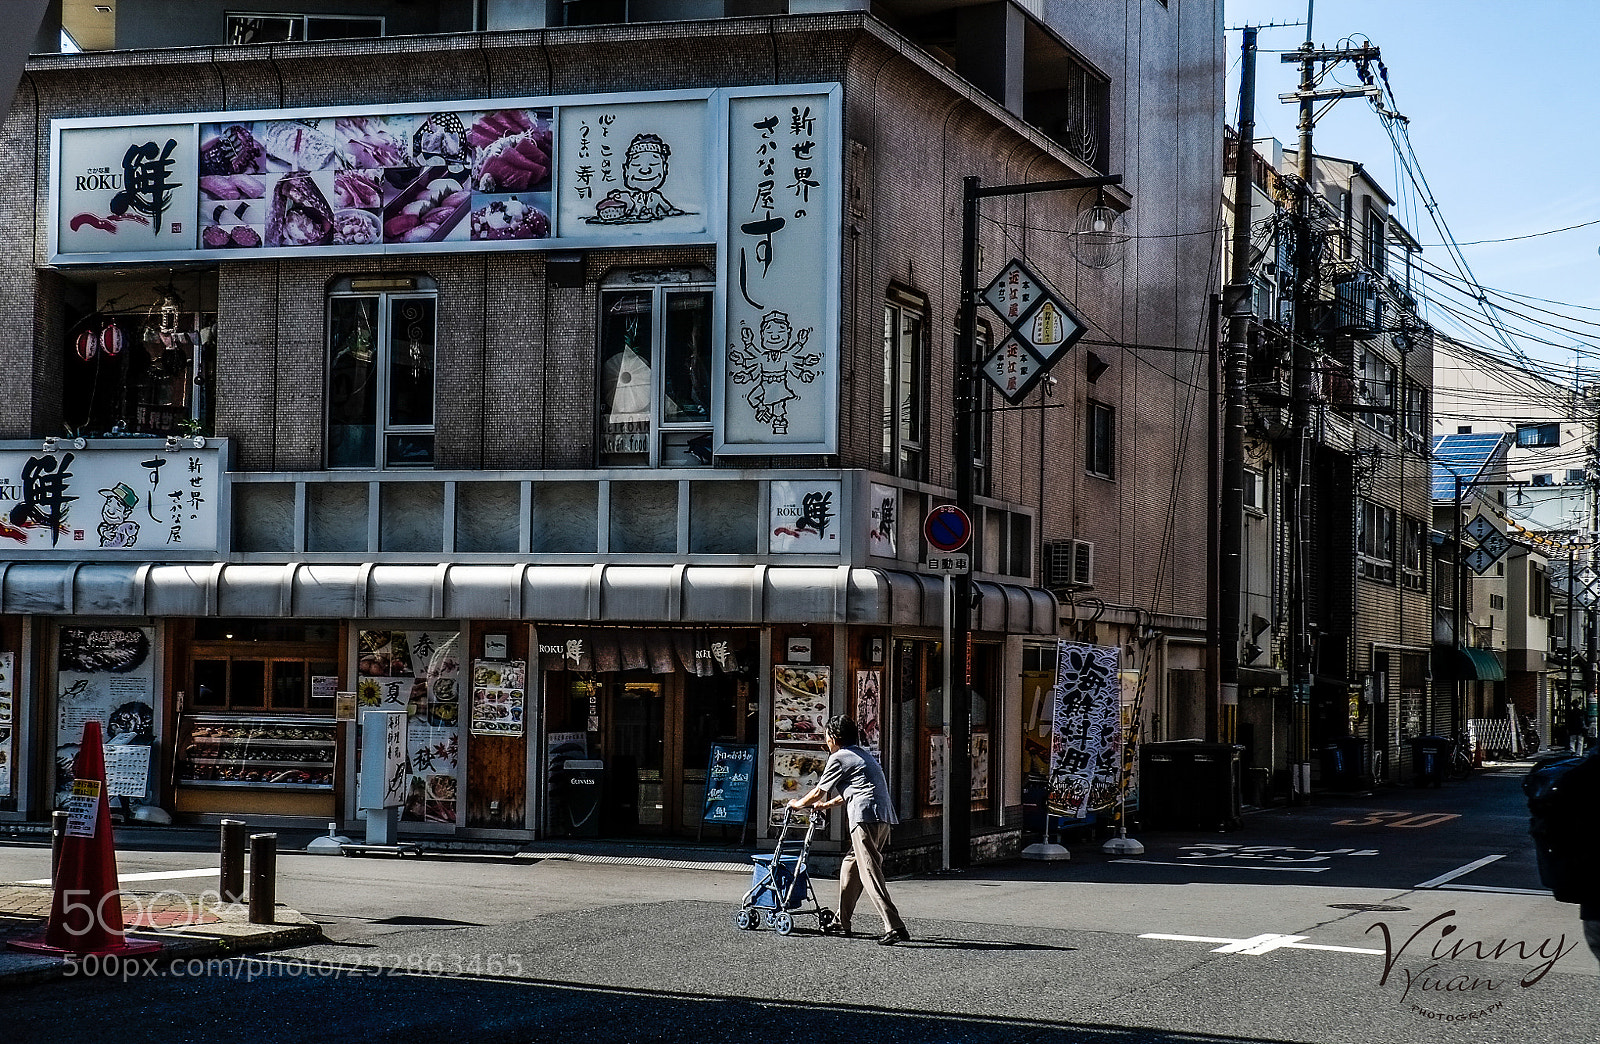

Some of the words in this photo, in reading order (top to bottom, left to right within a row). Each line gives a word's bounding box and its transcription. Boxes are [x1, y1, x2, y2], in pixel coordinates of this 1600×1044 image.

[574, 120, 596, 199] うまい寿司
[751, 115, 781, 214] さかな屋
[786, 106, 821, 219] 新世界の
[75, 173, 123, 191] ROKU
[140, 455, 167, 524] すし
[186, 456, 204, 520] 新世界の
[167, 489, 184, 545] さかな屋
[777, 507, 804, 517] ROKU
[929, 558, 967, 570] 自動車
[412, 632, 435, 660] 春
[538, 644, 564, 654] ROKU
[384, 680, 405, 706] 夏
[412, 748, 436, 772] 秋
[1331, 811, 1462, 828] 30
